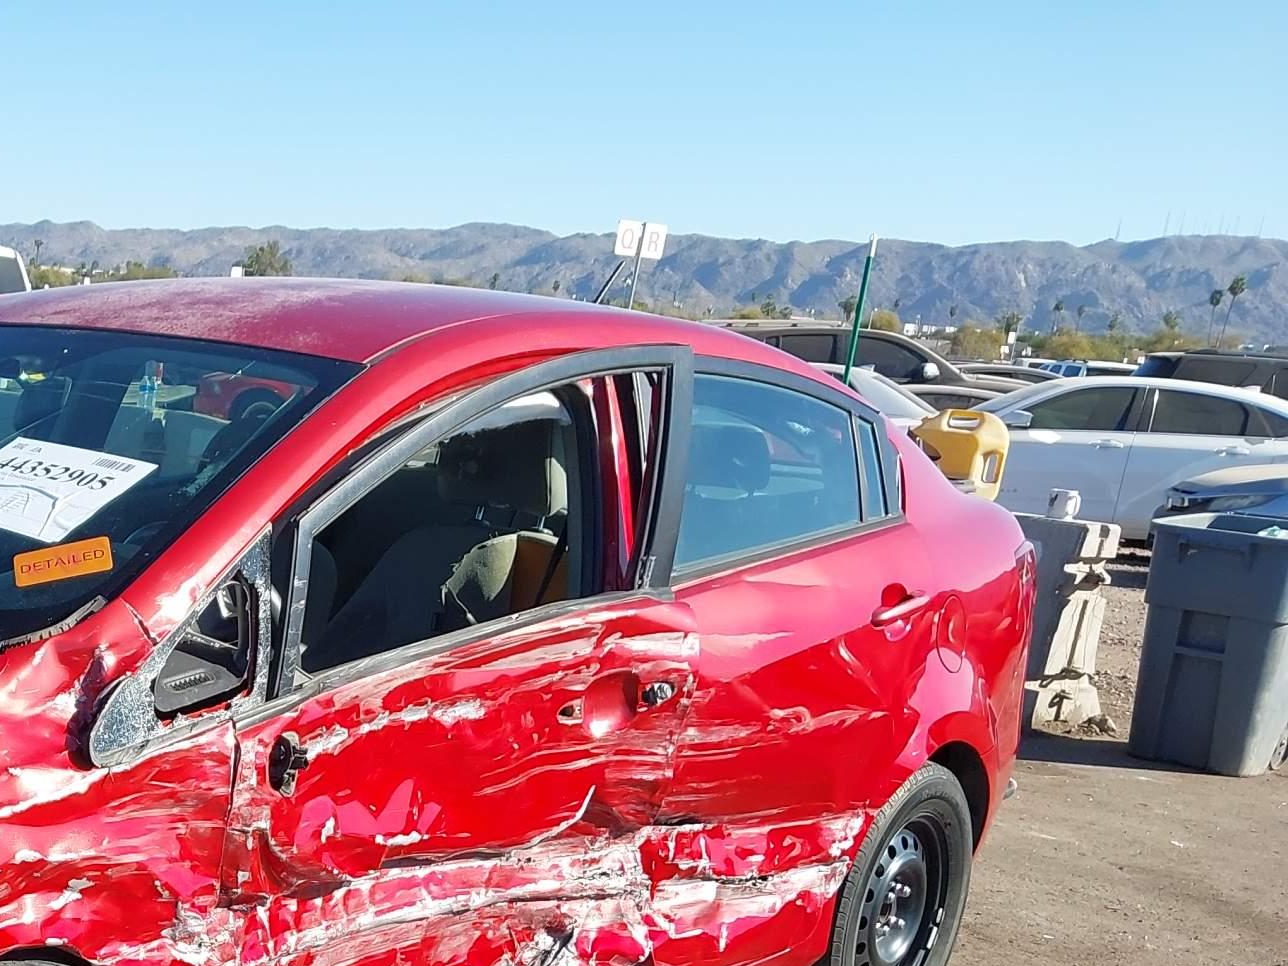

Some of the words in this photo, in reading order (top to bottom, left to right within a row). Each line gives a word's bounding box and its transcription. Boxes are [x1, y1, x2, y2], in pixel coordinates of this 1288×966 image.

[620, 228, 635, 249] Q
[647, 231, 660, 252] R
[20, 549, 105, 575] DETAILED
